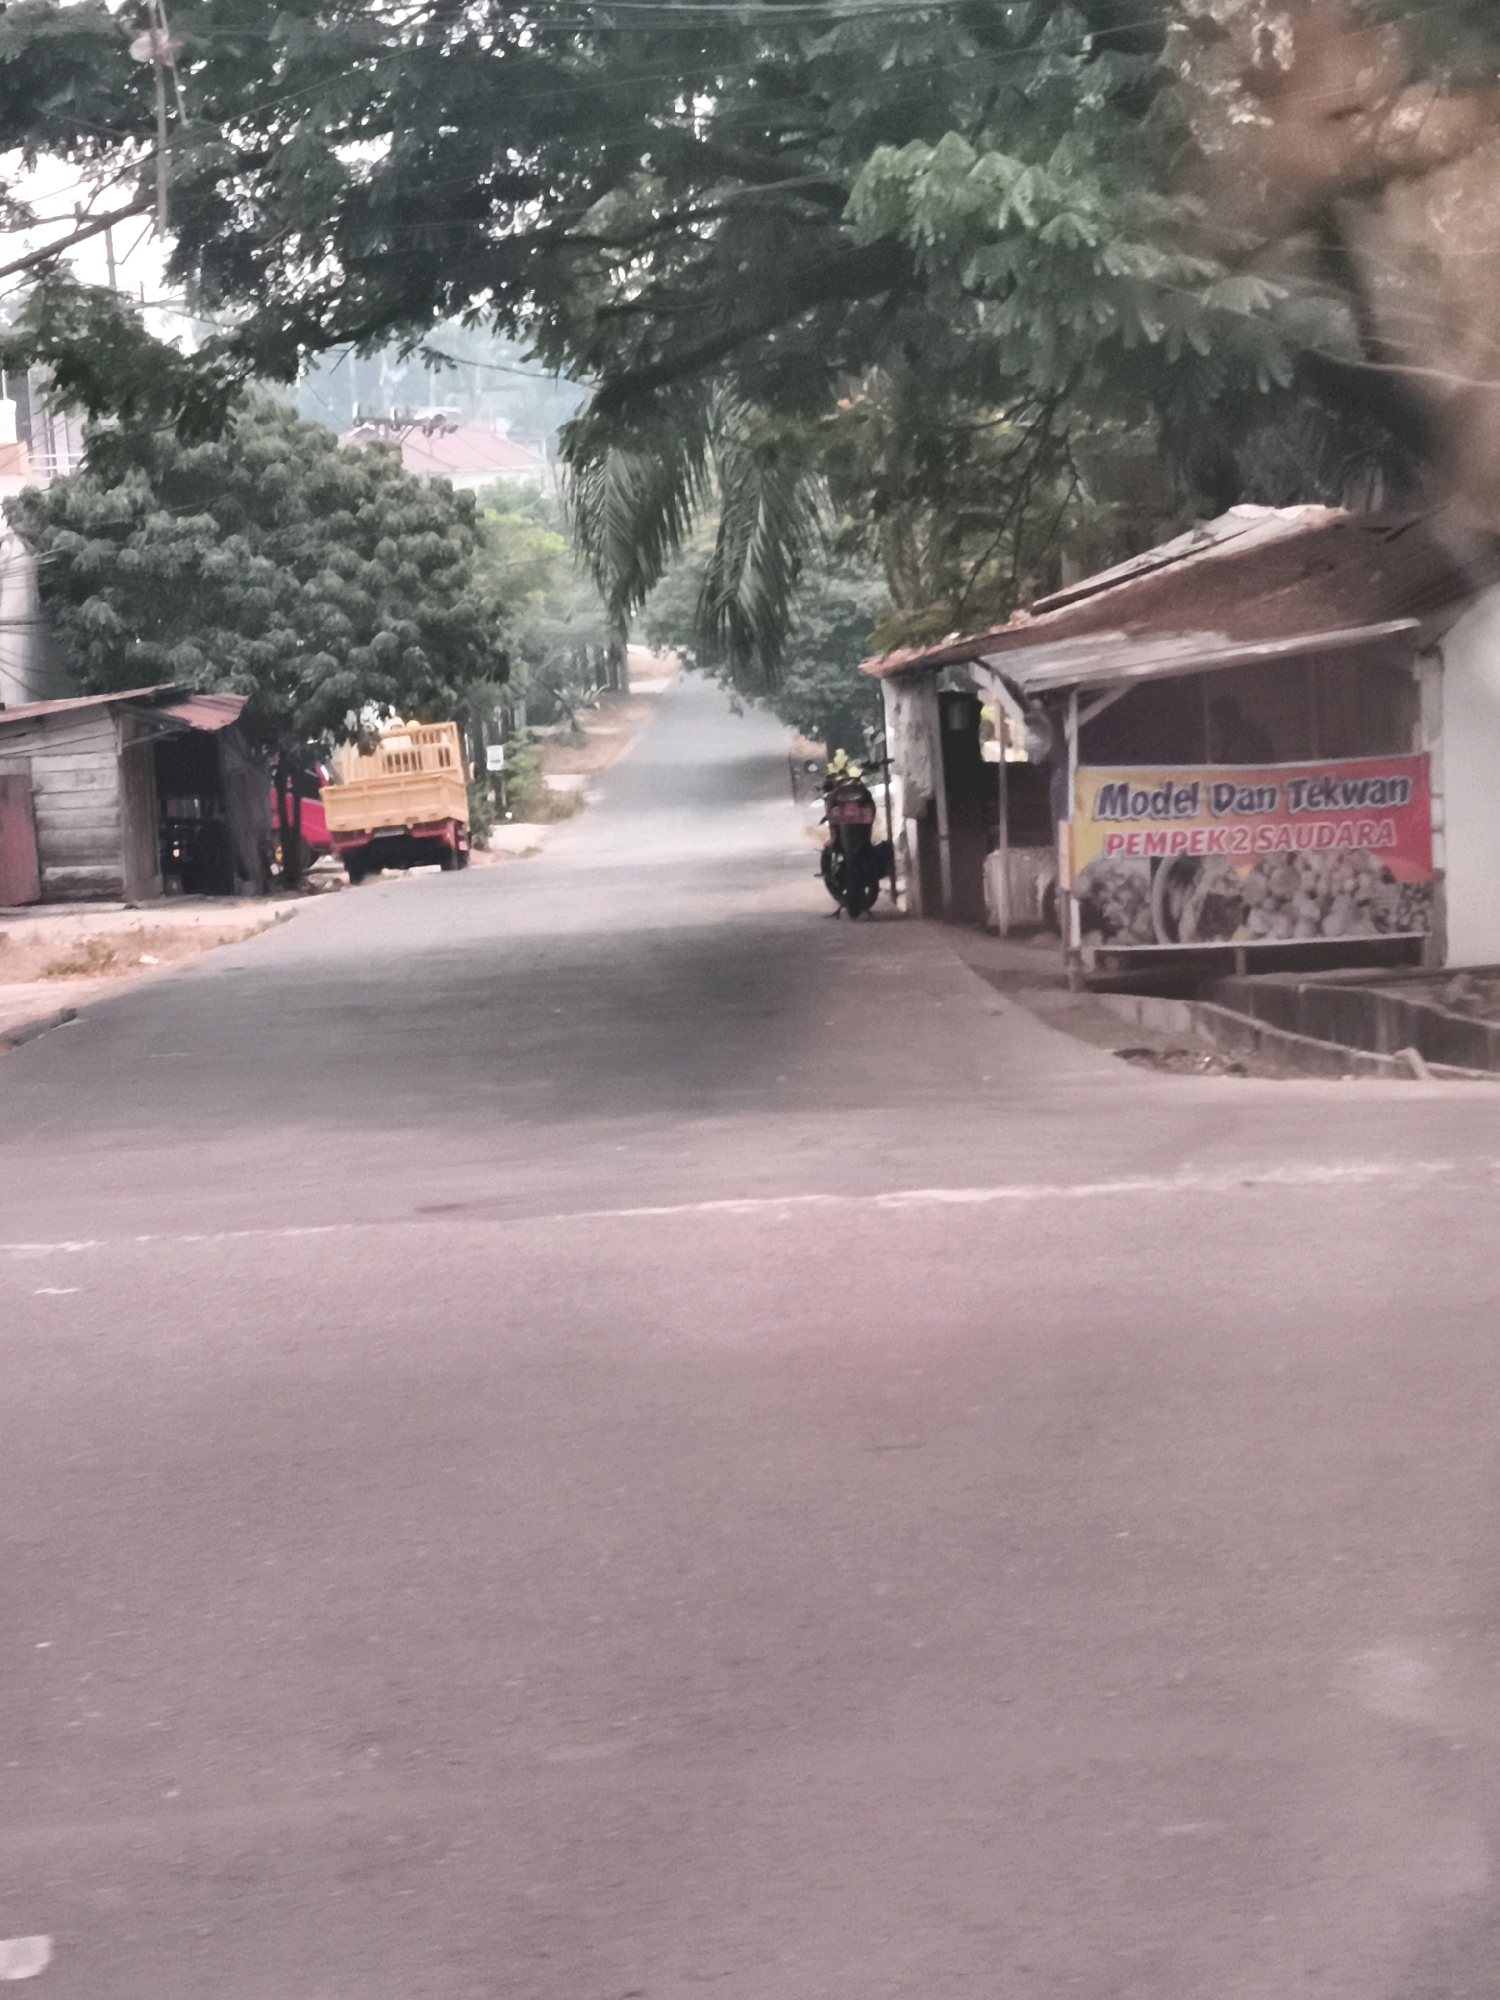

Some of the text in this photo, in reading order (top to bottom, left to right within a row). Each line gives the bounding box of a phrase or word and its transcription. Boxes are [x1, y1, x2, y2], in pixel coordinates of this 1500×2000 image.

[1095, 777, 1411, 821] Model Dan Tekwan
[1106, 819, 1398, 857] PEMPEK 2 SAUDARA
